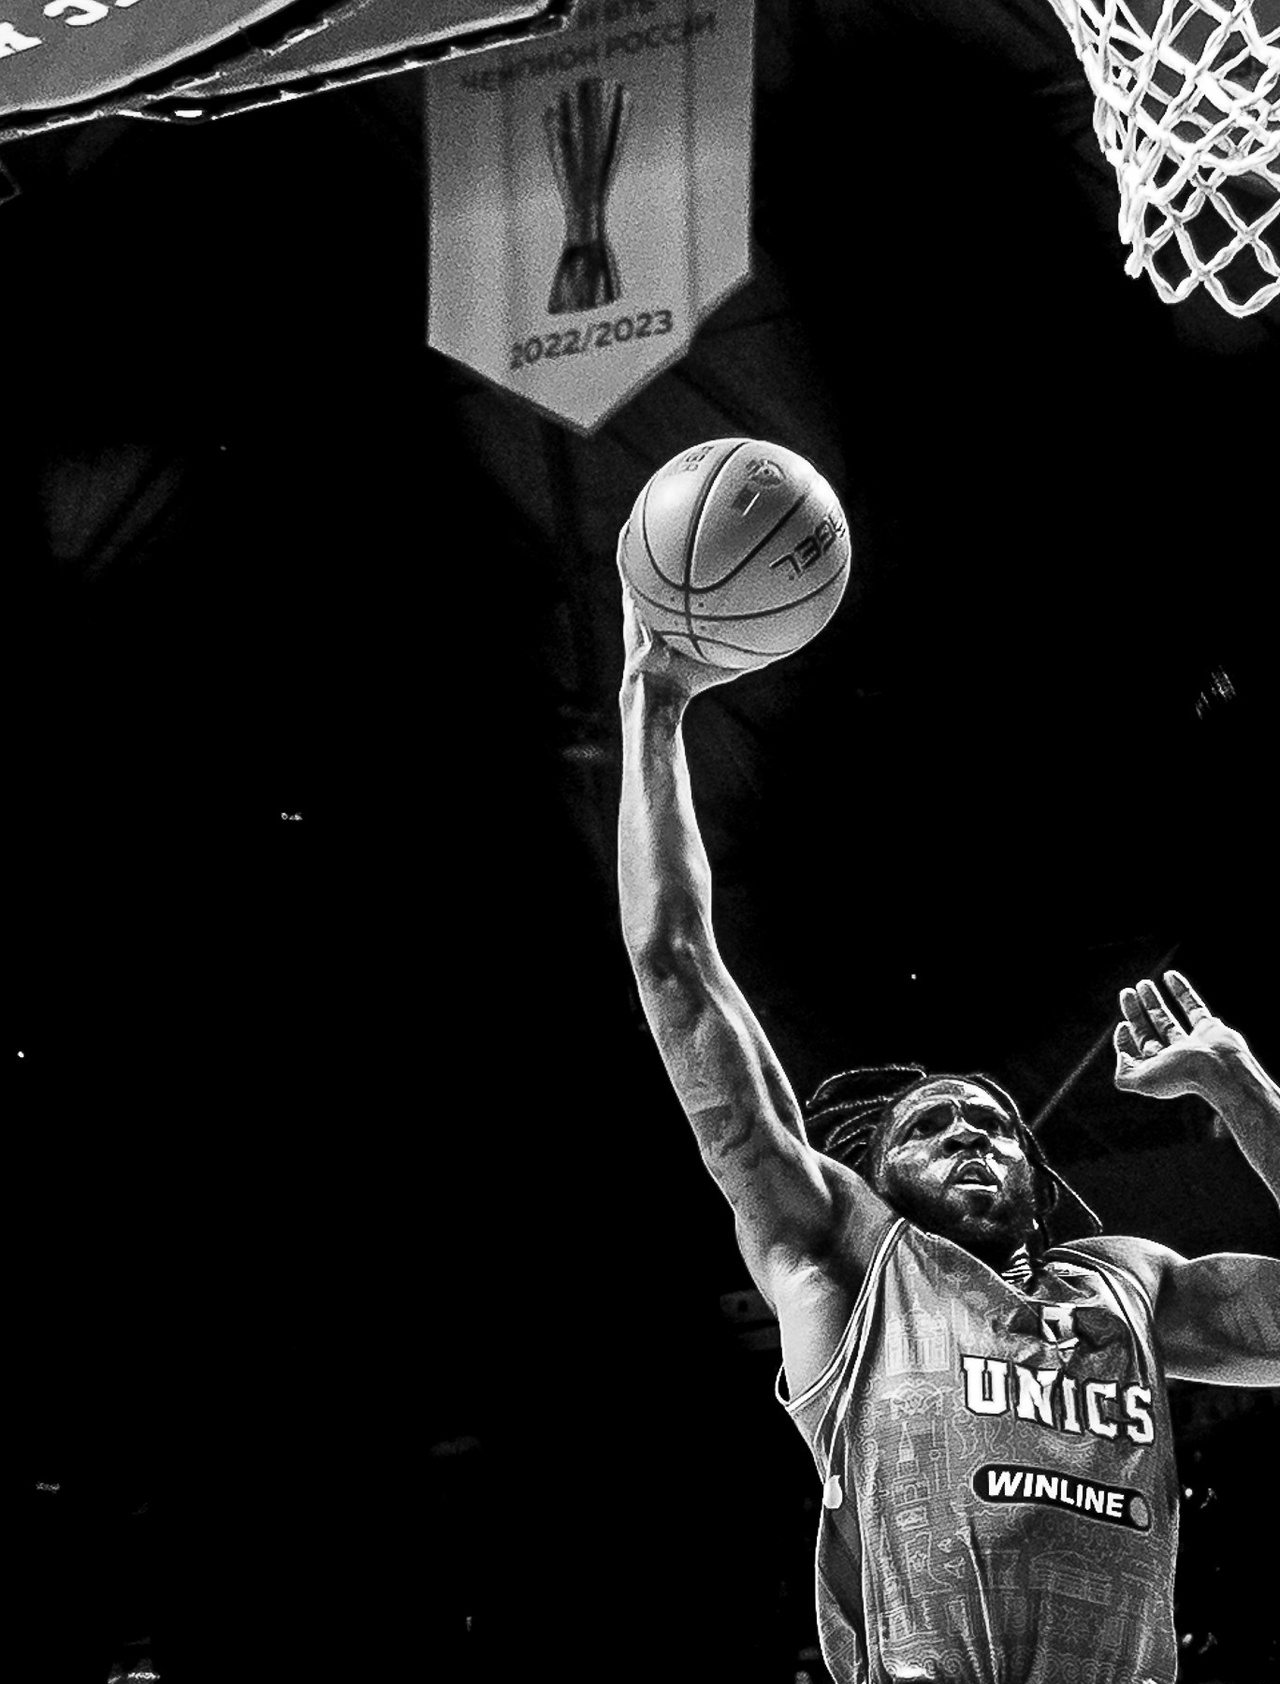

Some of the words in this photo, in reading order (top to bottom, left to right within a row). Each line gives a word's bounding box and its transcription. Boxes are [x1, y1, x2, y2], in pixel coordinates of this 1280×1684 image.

[510, 310, 673, 369] 2022/2023
[961, 1354, 1154, 1445] UNICS
[987, 1470, 1125, 1518] WINLINE
